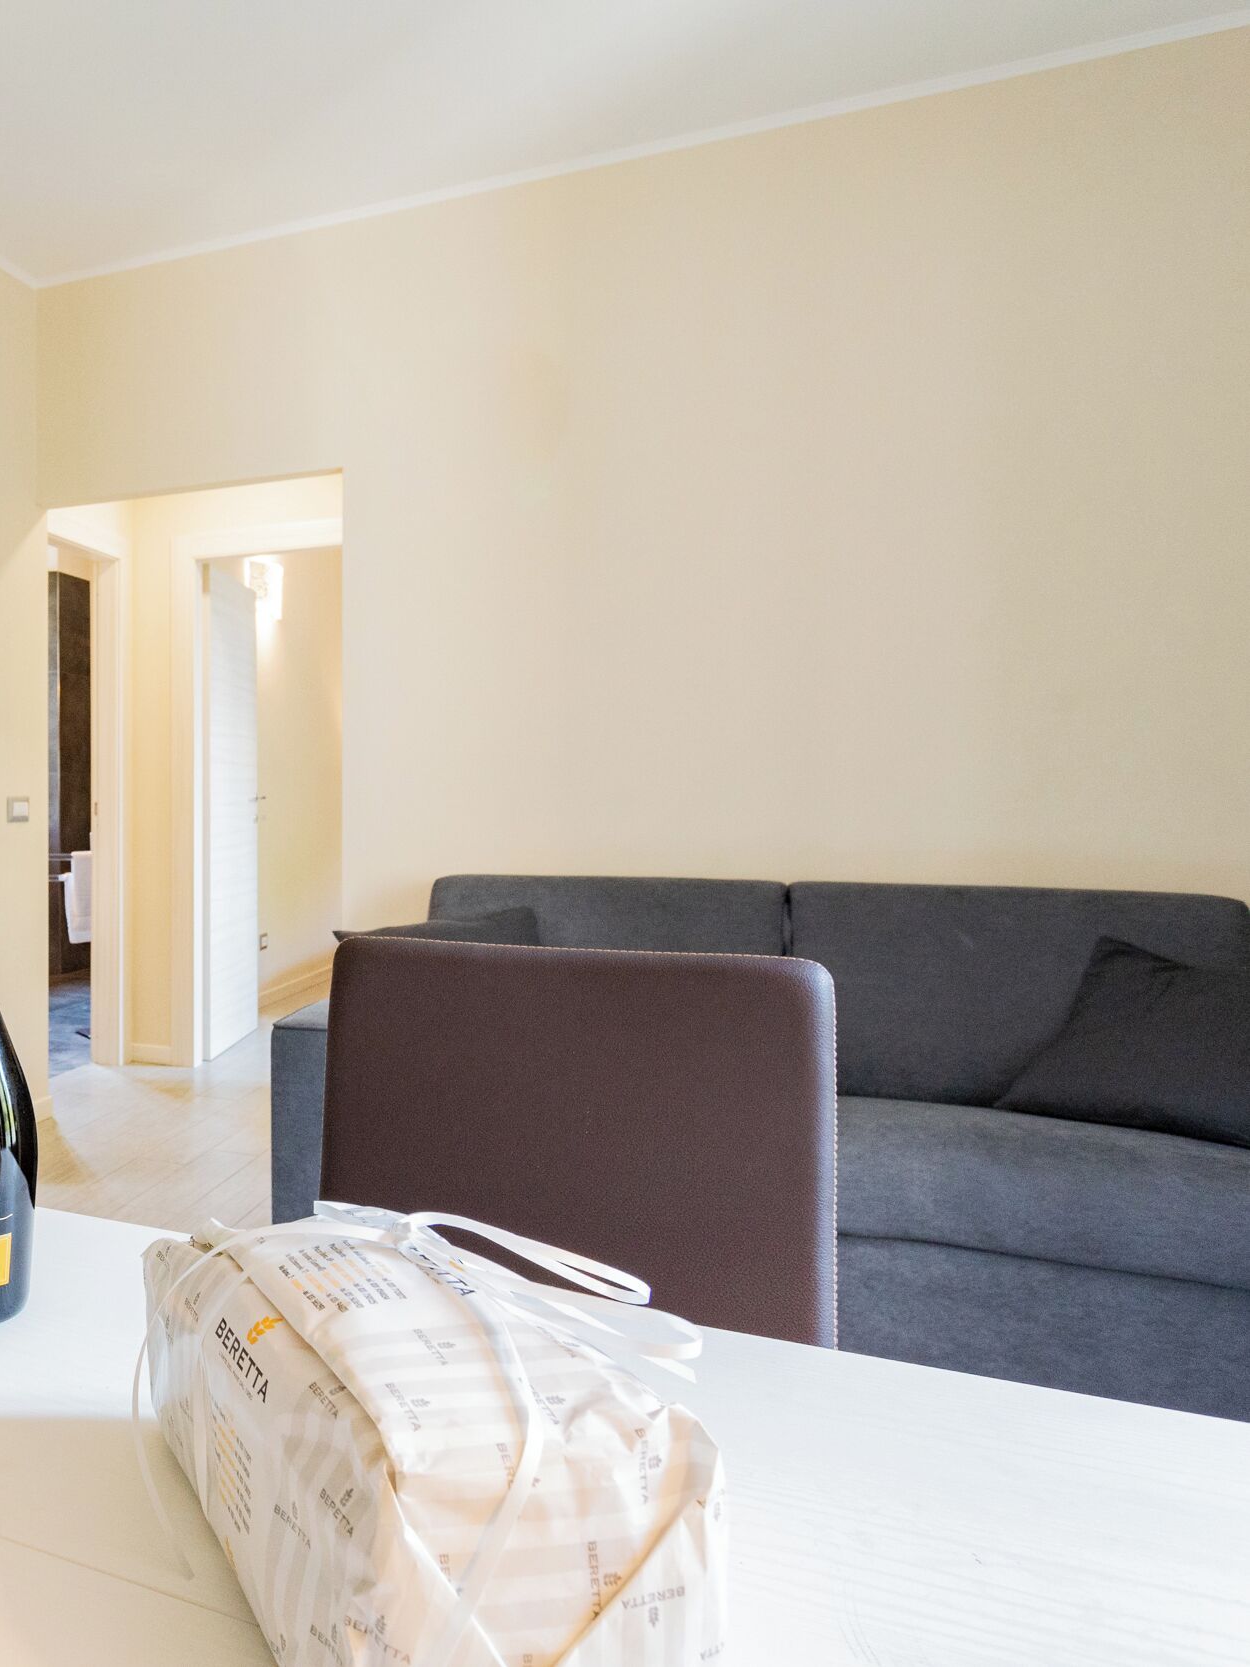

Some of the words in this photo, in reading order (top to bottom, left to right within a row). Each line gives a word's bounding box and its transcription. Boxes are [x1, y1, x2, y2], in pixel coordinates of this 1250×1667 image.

[215, 1317, 269, 1403] BERETTA
[413, 1328, 448, 1366] BERETTA
[309, 1381, 339, 1419] BERETTA
[384, 1382, 422, 1432] BERETTA
[622, 1585, 686, 1610] BERETTA
